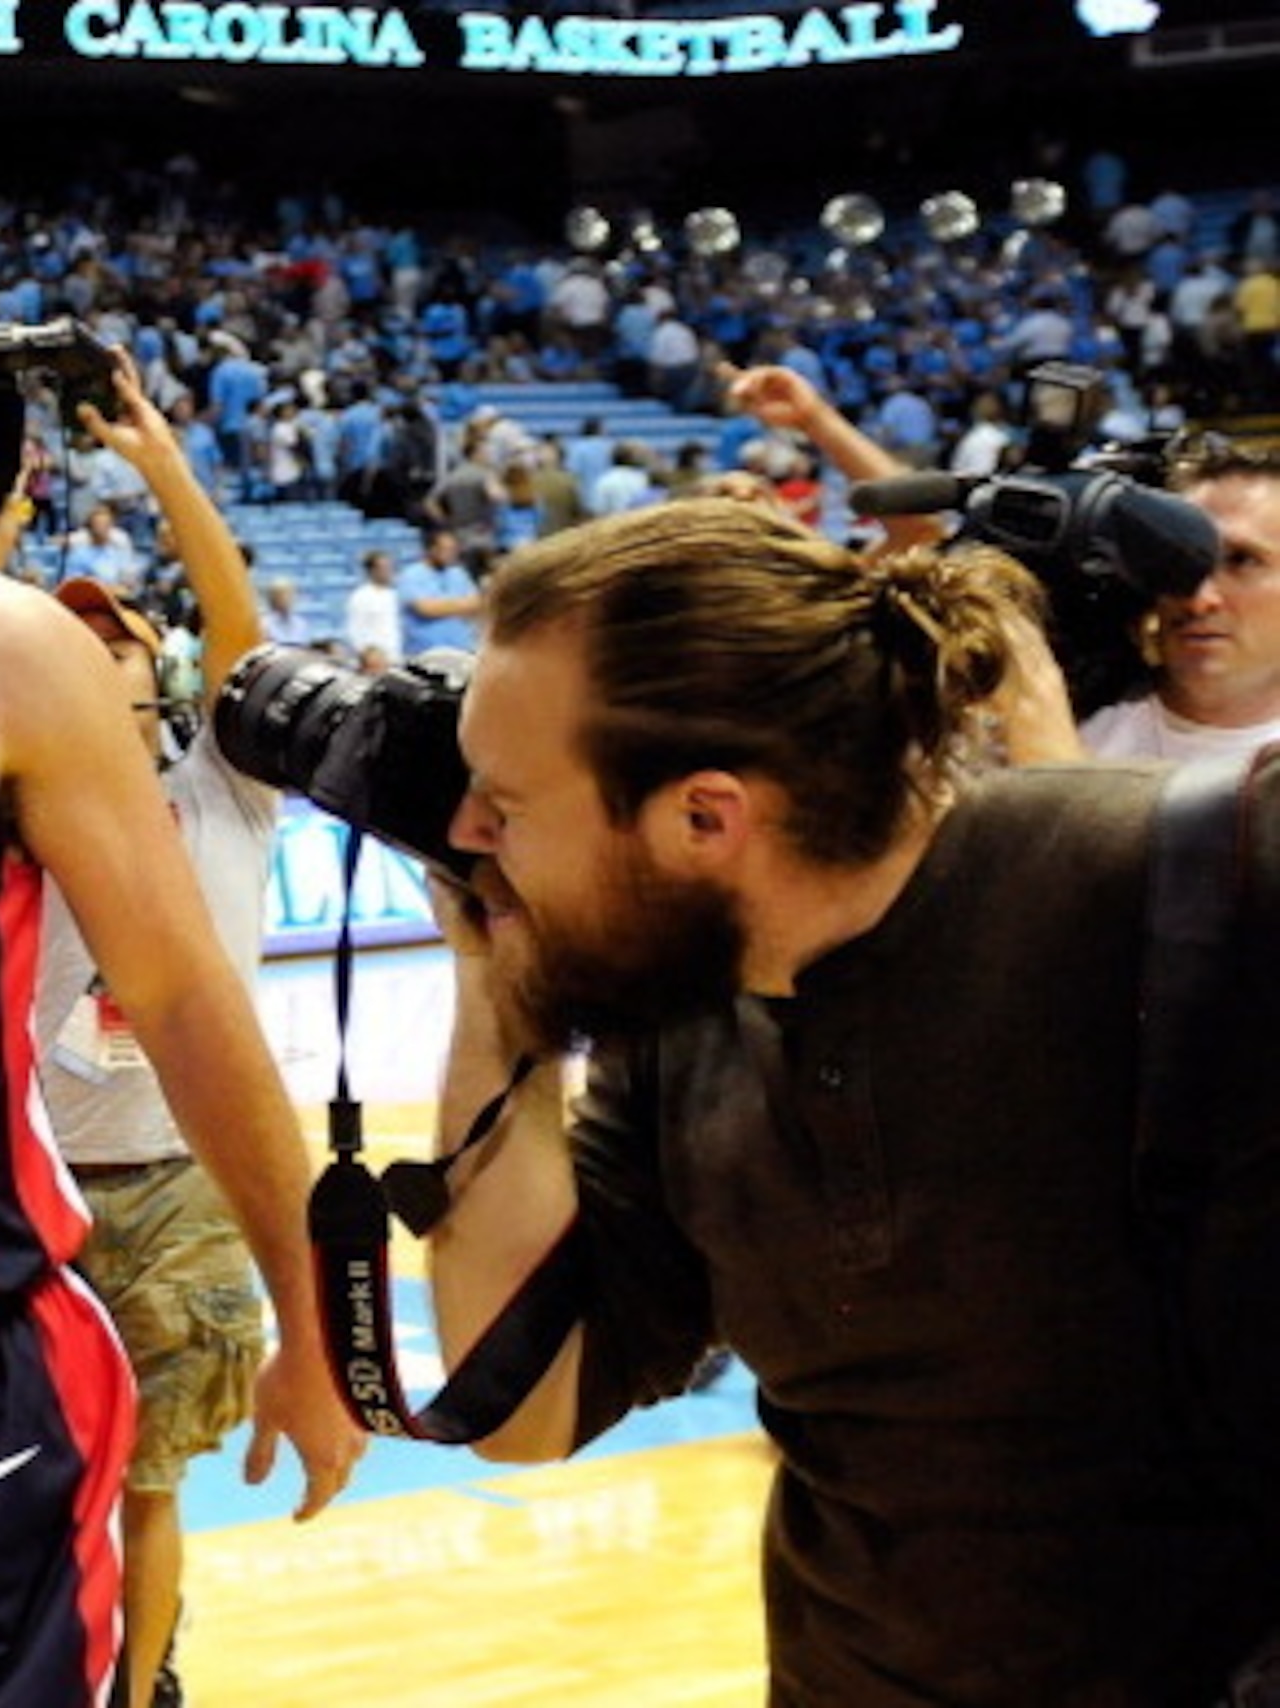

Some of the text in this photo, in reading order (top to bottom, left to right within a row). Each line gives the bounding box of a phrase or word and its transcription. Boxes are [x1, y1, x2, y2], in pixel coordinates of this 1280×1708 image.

[63, 0, 426, 68] CAROLINA
[458, 2, 963, 76] BASKETBALL
[347, 1279, 377, 1351] Mark
